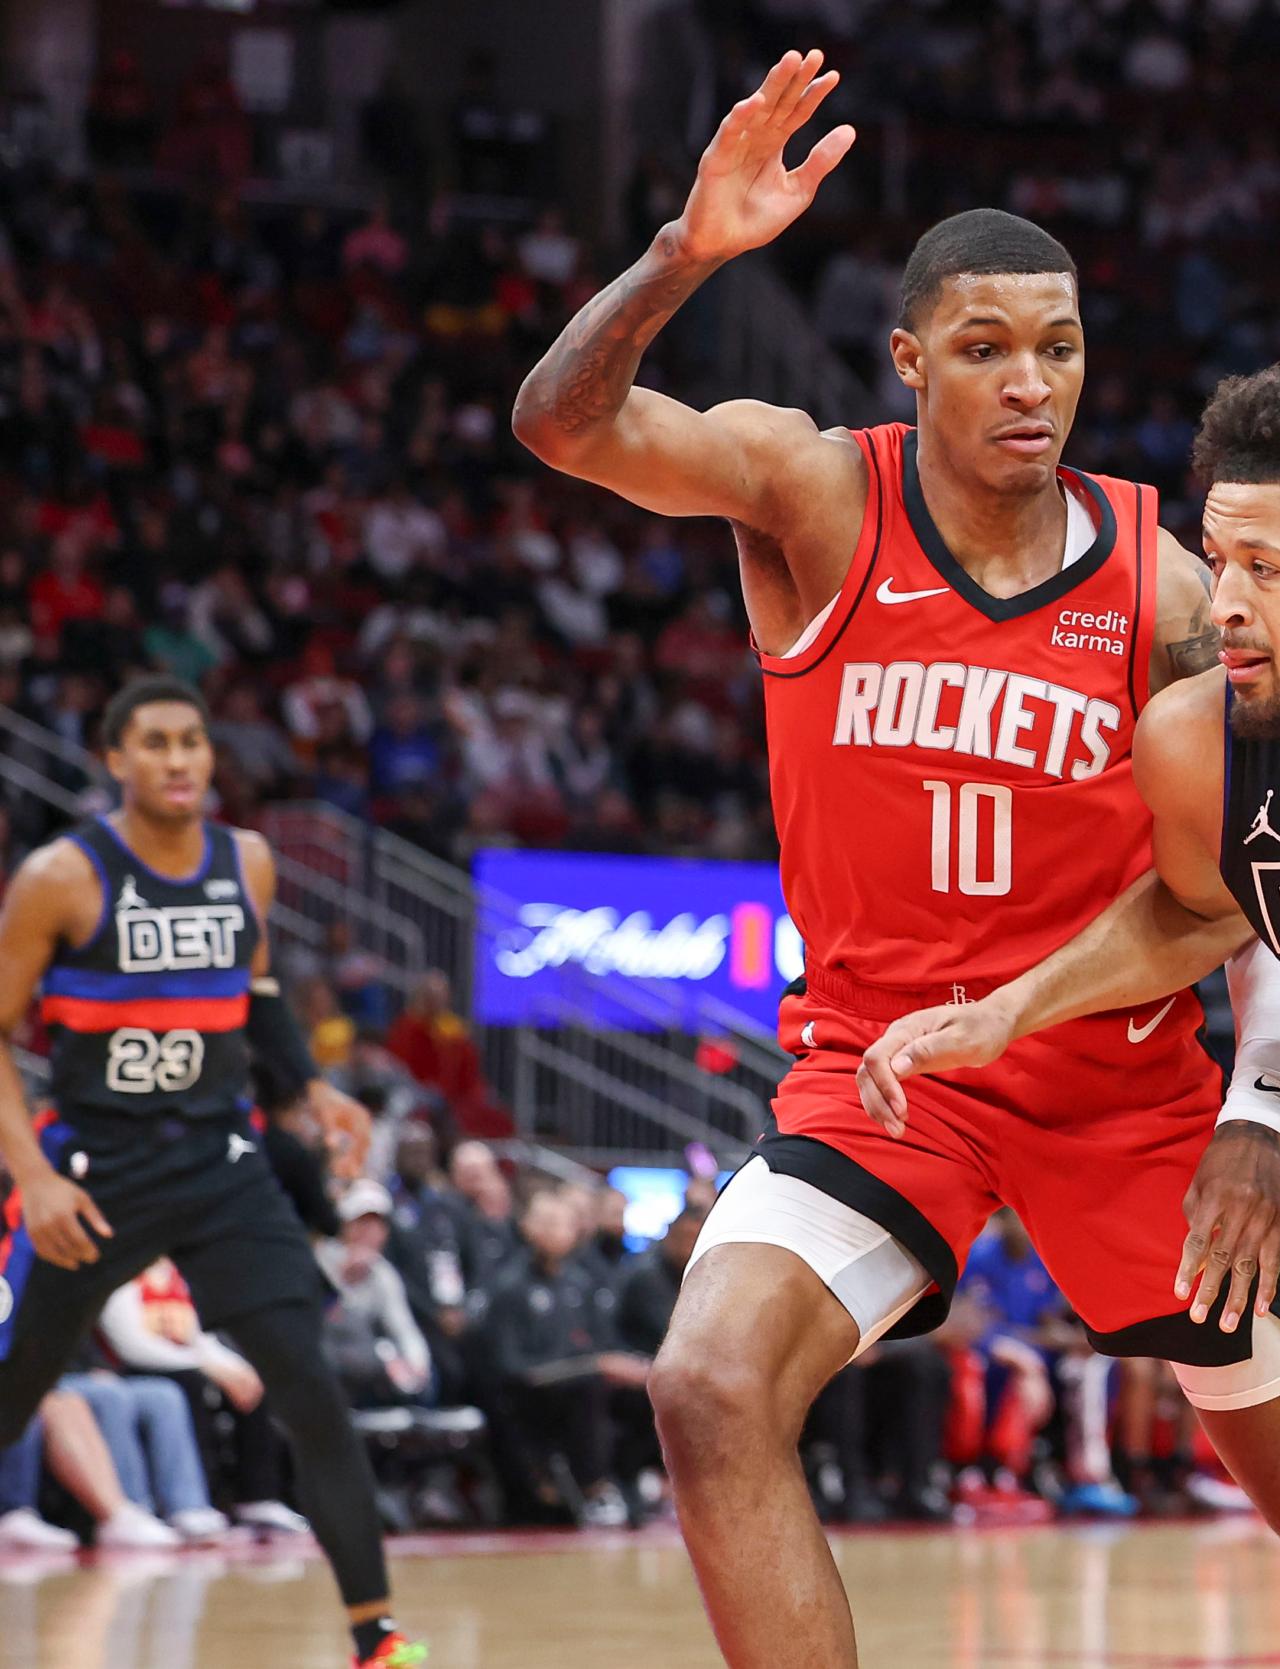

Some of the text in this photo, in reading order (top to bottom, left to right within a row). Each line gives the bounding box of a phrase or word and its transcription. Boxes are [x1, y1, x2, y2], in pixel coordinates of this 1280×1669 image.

[1050, 626, 1125, 656] karma
[1058, 607, 1129, 635] credit
[832, 661, 1121, 782] ROCKETS
[922, 780, 1013, 896] 10
[116, 903, 245, 973] DET
[106, 1026, 205, 1094] 23
